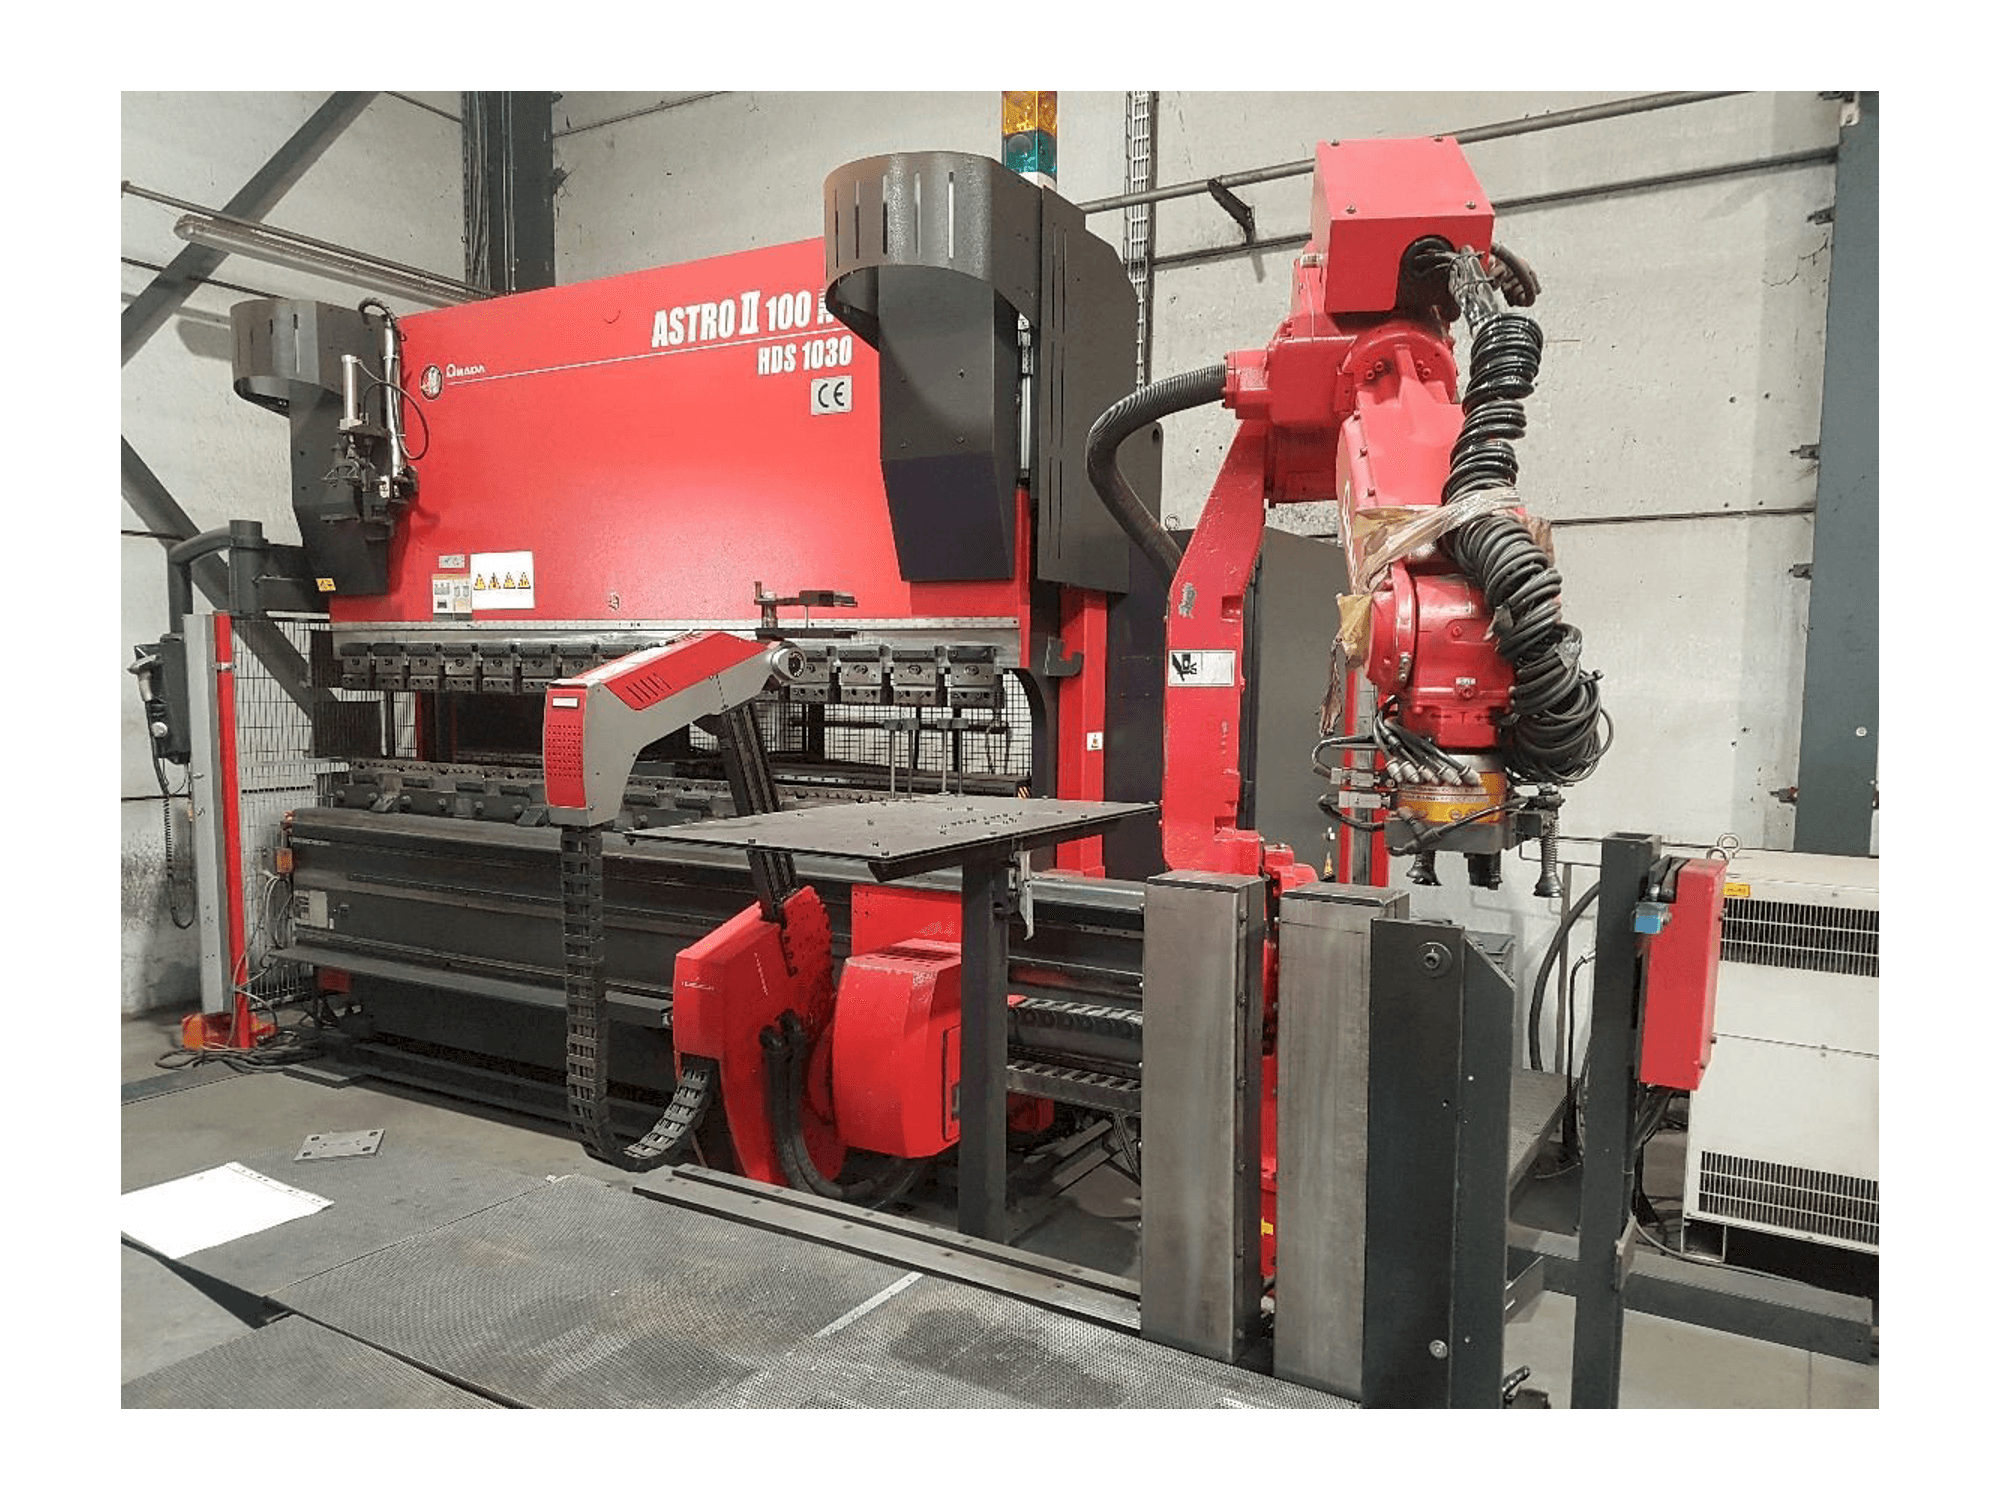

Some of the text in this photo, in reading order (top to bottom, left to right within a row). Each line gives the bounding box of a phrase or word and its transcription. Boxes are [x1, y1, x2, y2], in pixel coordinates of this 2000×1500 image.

[651, 298, 735, 348] ASTRO
[739, 290, 761, 335] II
[765, 290, 812, 332] 100
[757, 335, 853, 375] HDS 1030
[817, 381, 845, 408] CE
